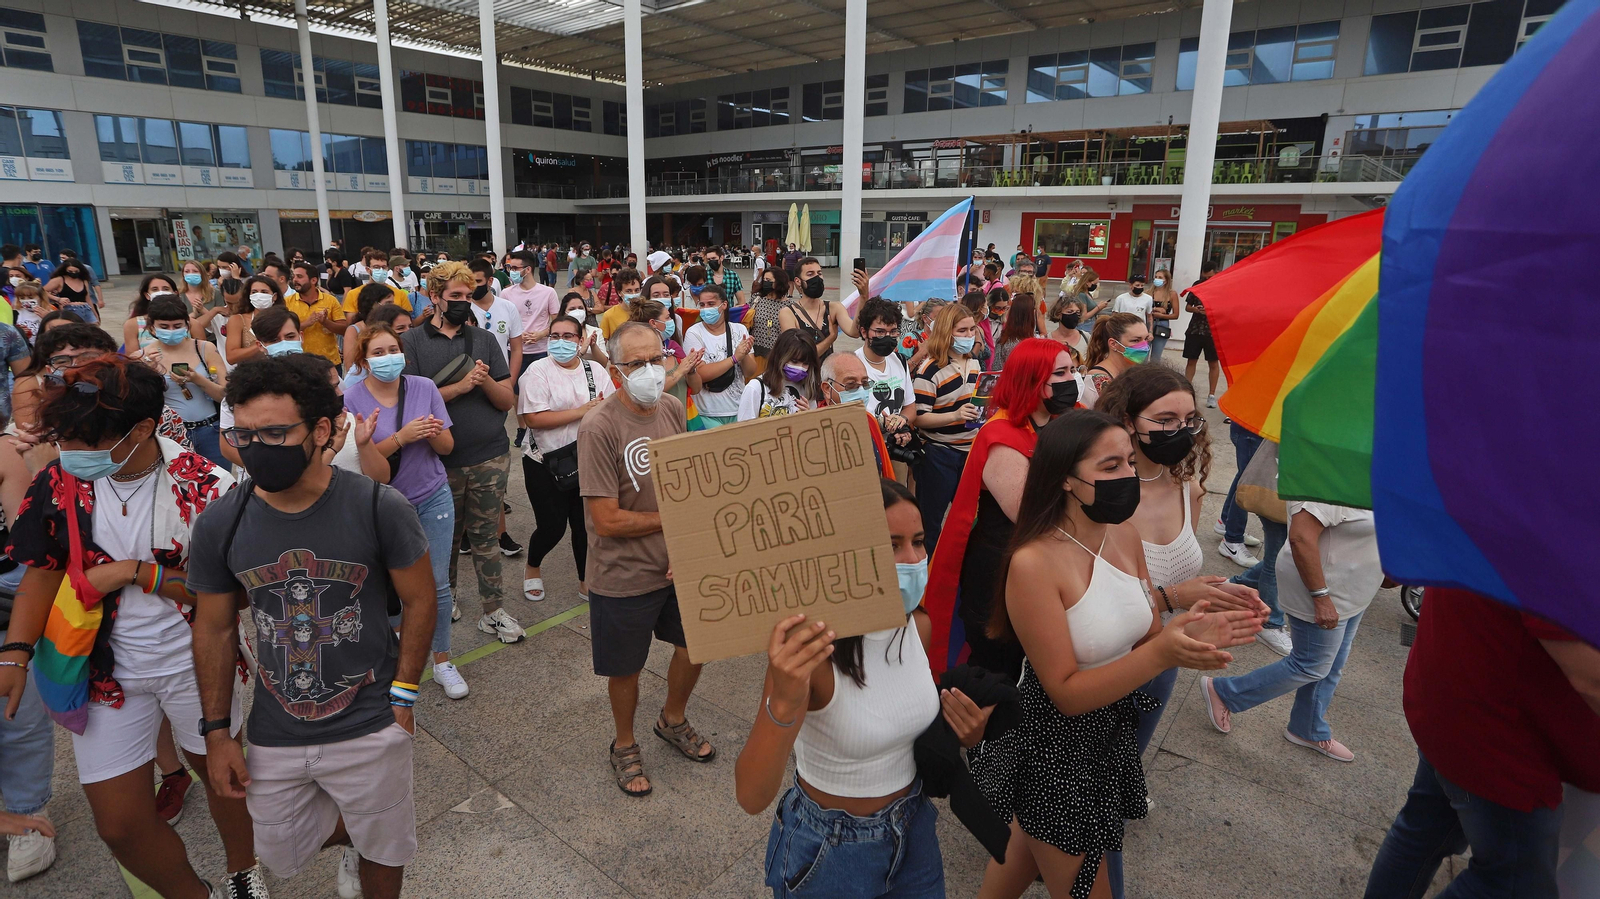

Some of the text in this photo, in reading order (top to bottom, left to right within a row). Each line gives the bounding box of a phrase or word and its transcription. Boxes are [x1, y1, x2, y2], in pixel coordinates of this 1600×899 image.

[719, 153, 743, 163] noodles
[1222, 205, 1256, 216] market
[212, 212, 252, 226] hogarium
[451, 212, 473, 220] PLAZA
[175, 220, 186, 229] RE
[177, 229, 188, 238] BA
[178, 238, 191, 247] JAS
[713, 486, 836, 558] PARA
[241, 565, 278, 588] UNS
[315, 561, 365, 582] ROSES
[698, 546, 885, 622] SAMUEL!
